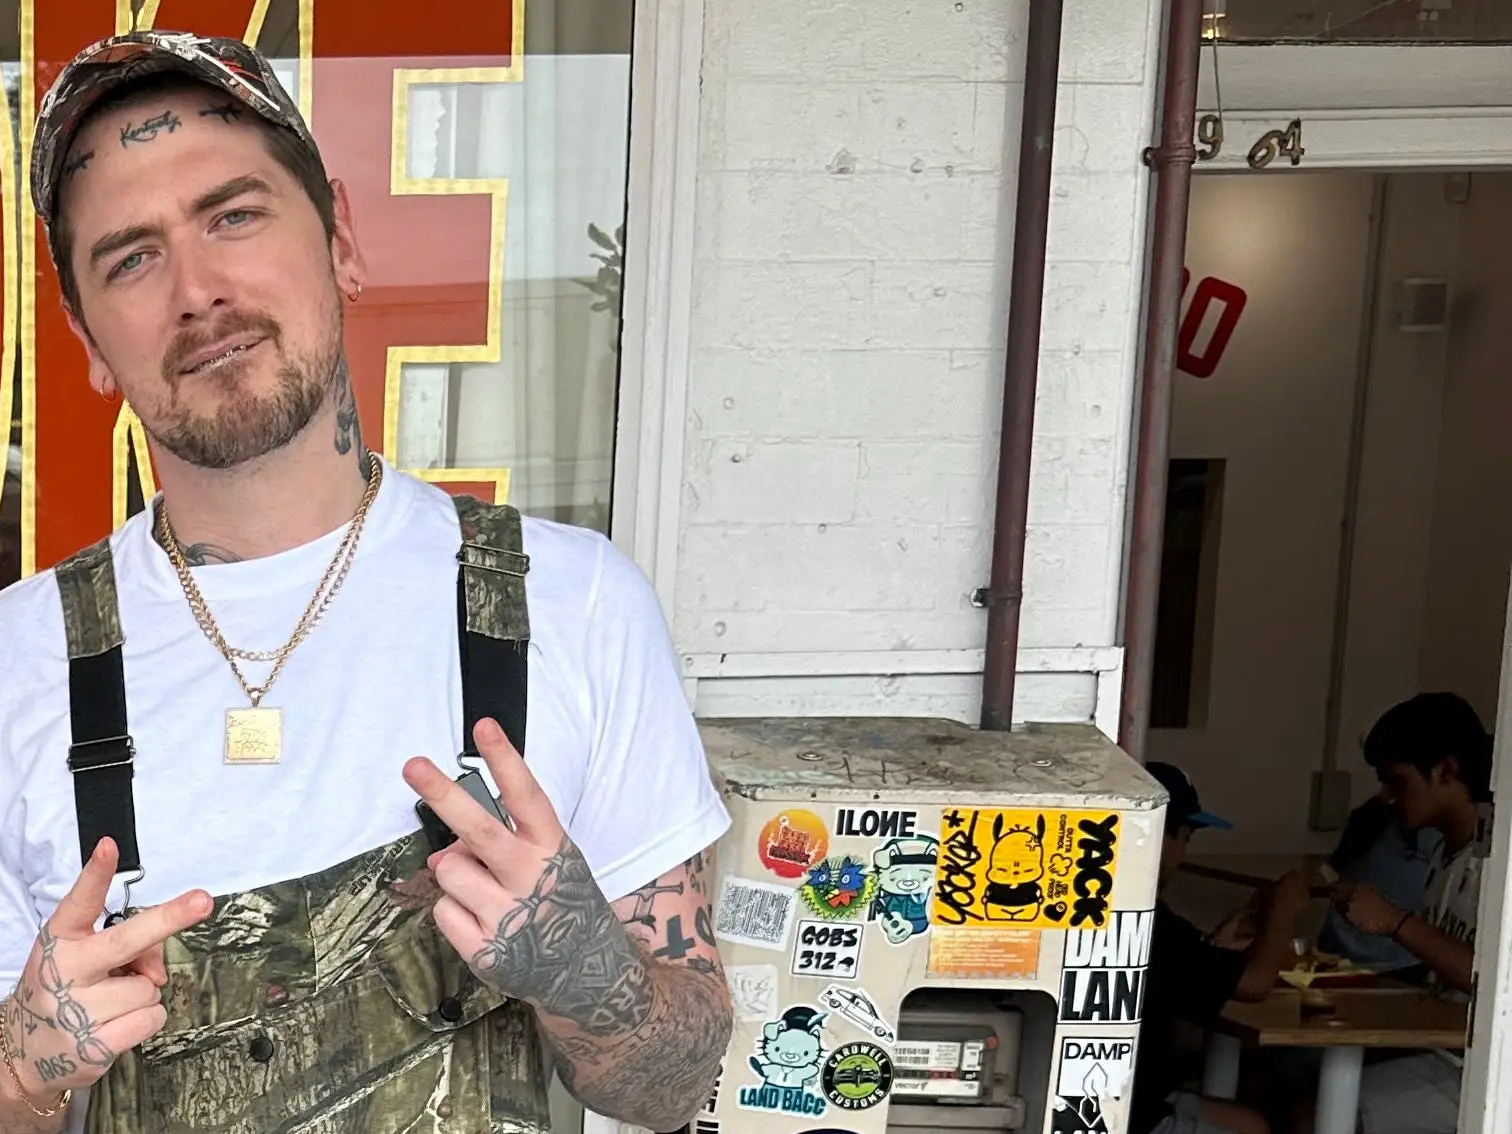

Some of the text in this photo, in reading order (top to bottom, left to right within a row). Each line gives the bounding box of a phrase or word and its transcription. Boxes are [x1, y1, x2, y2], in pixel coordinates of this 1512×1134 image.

[799, 951, 836, 971] 312
[829, 1042, 887, 1068] CARDWELL
[1064, 1042, 1131, 1060] DAMP
[740, 1088, 782, 1108] LAND
[829, 1088, 885, 1110] CUSTOMS
